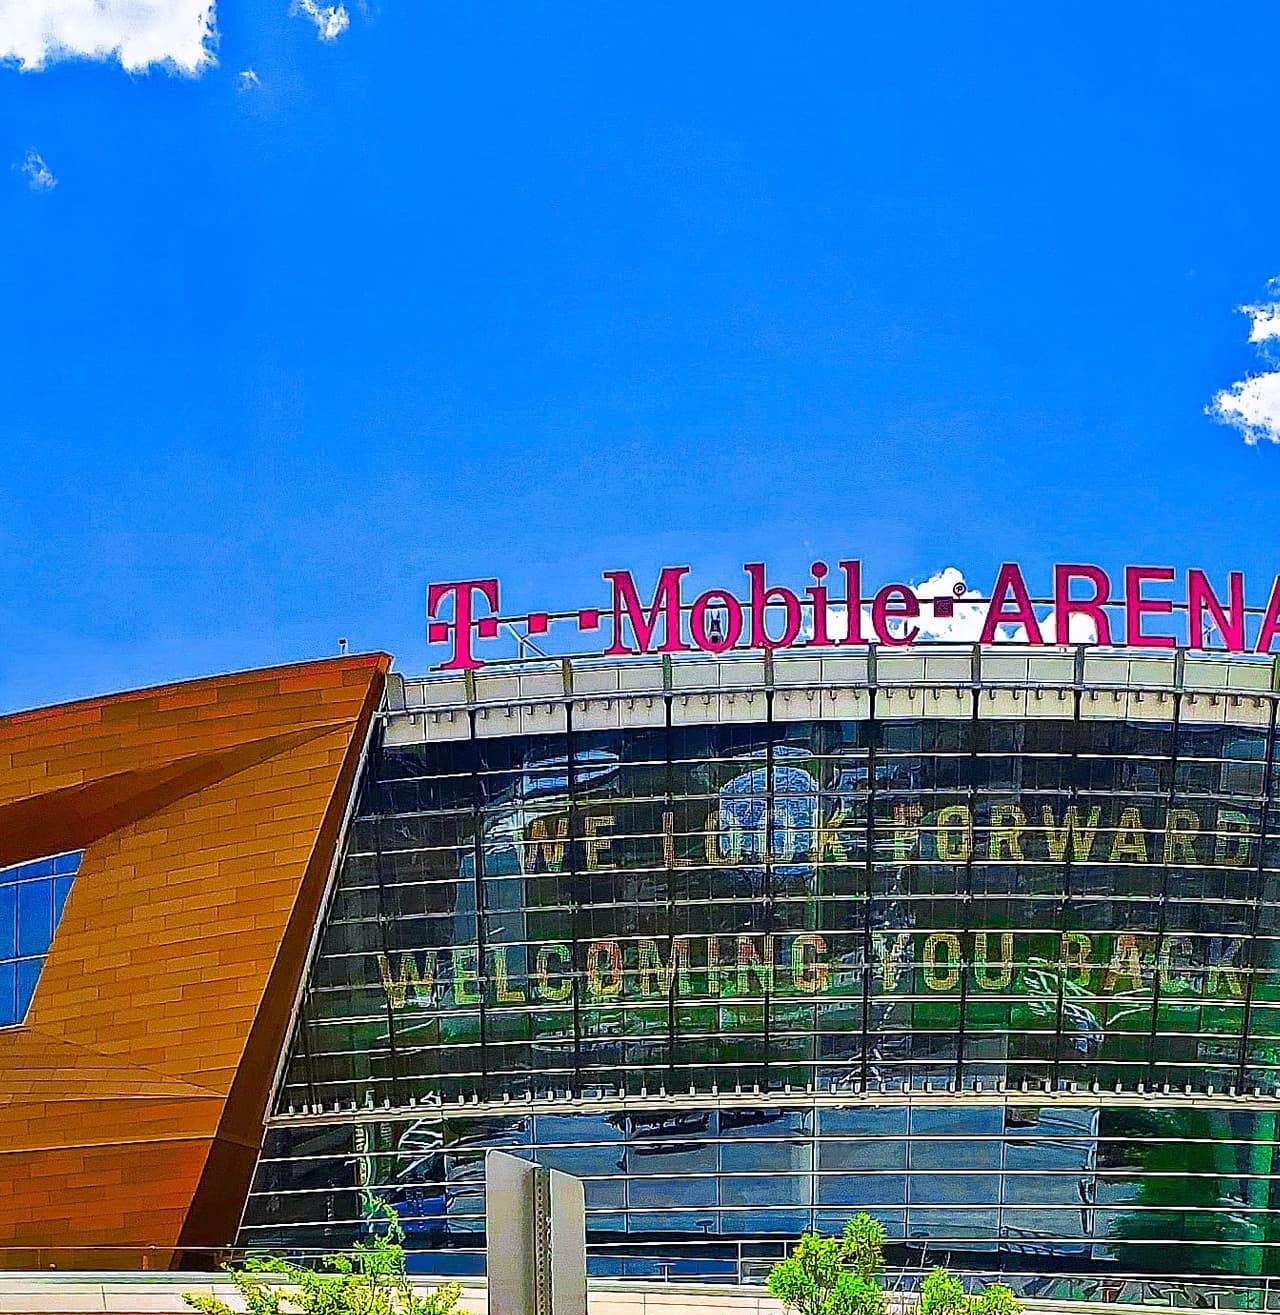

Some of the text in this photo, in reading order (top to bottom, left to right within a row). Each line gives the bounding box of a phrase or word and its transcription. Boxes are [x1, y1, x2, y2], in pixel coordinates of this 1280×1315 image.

[521, 815, 617, 874] WE
[662, 810, 850, 870] LOOK
[893, 802, 1251, 867] FORWARD
[376, 934, 834, 1008] WELCOMING
[871, 931, 1013, 992] YOU
[1061, 933, 1246, 998] BACK
